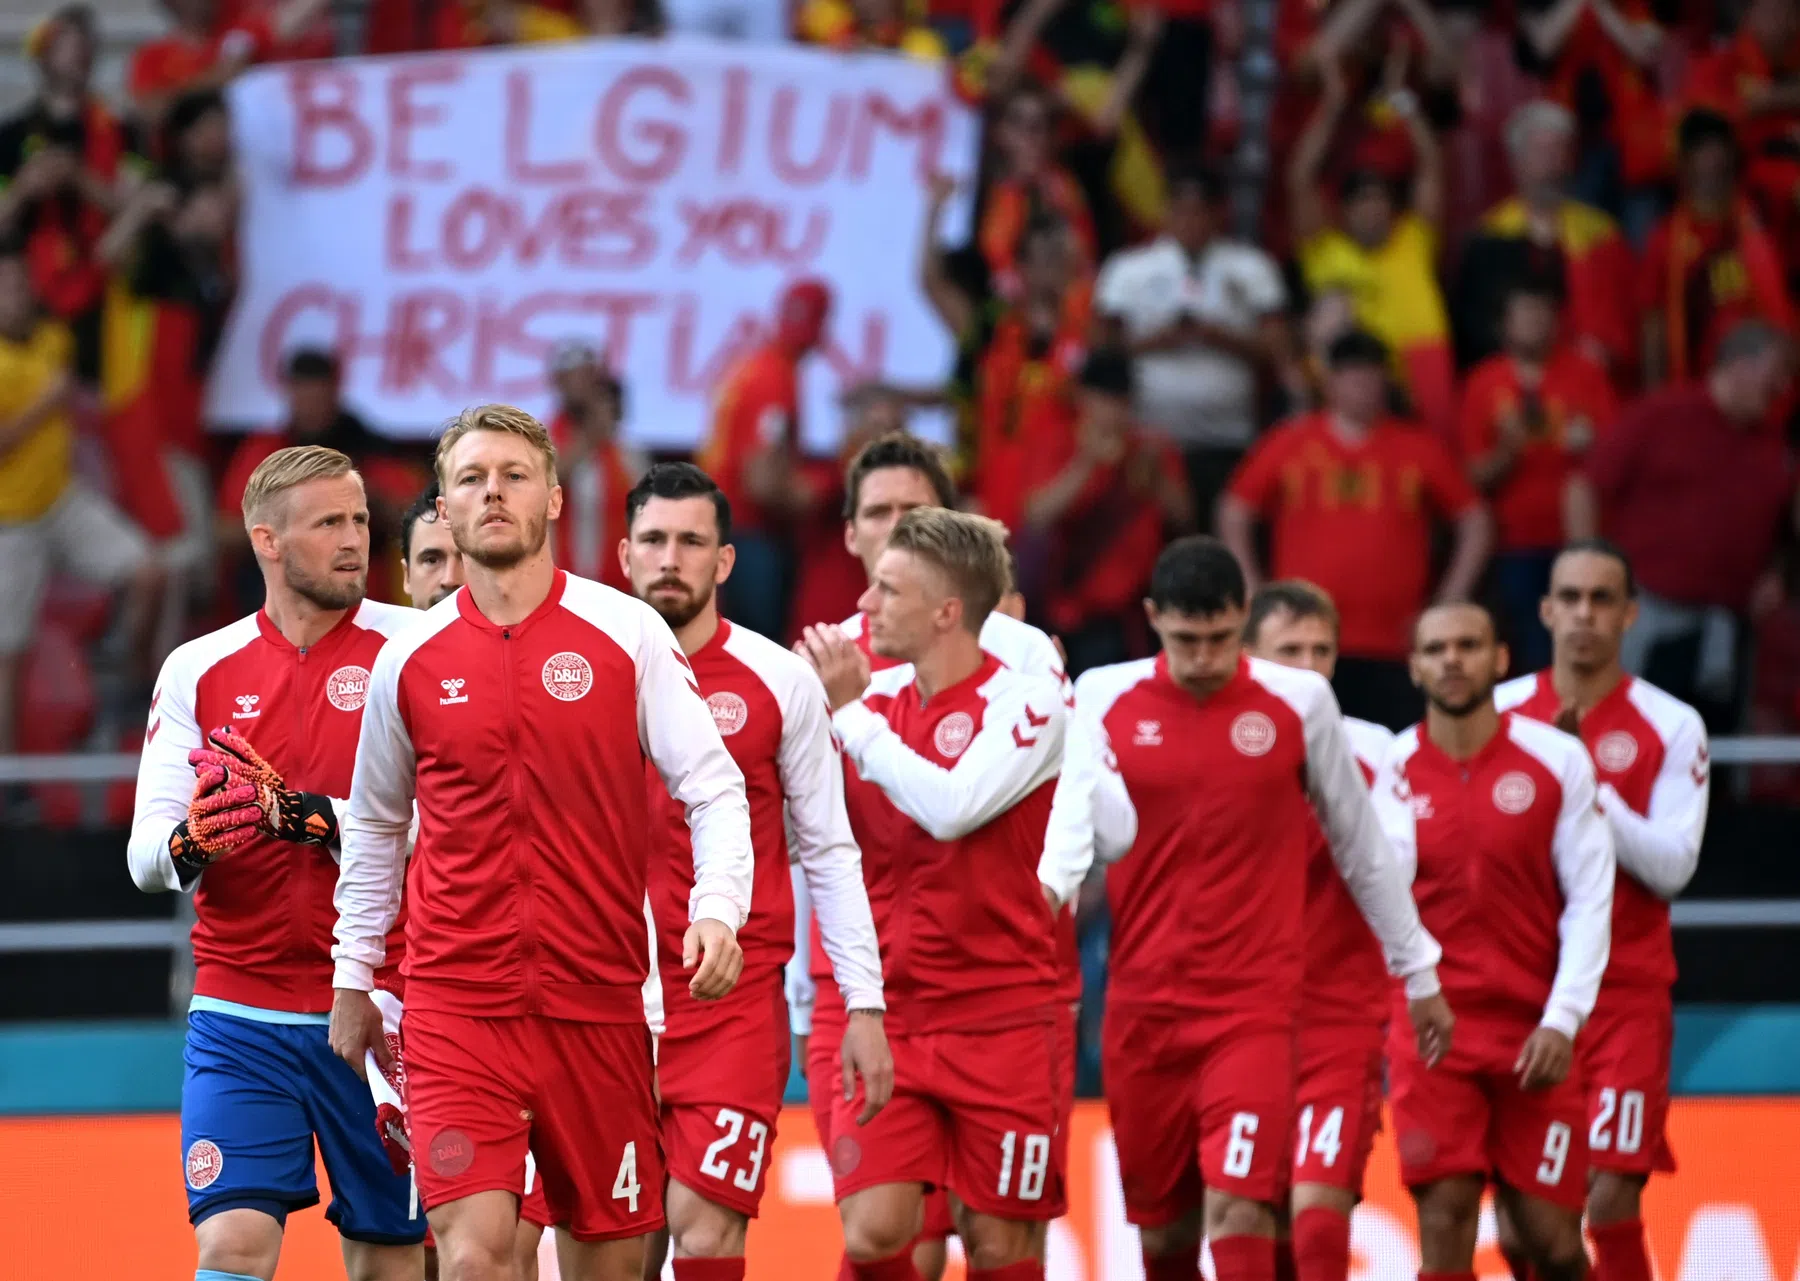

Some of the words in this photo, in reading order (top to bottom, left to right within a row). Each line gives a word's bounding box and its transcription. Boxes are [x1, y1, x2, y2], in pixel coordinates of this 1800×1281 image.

[285, 62, 946, 188] BELGIUM
[386, 186, 660, 272] LOVES
[677, 203, 830, 267] YOU
[337, 681, 364, 695] DBU
[553, 668, 582, 682] DBU
[700, 1108, 768, 1192] 23
[1223, 1113, 1258, 1178] 6
[1296, 1106, 1343, 1167] 14
[1589, 1088, 1645, 1154] 20
[191, 1154, 213, 1173] DBU
[612, 1140, 641, 1213] 4
[998, 1131, 1050, 1200] 18
[1537, 1122, 1571, 1186] 9
